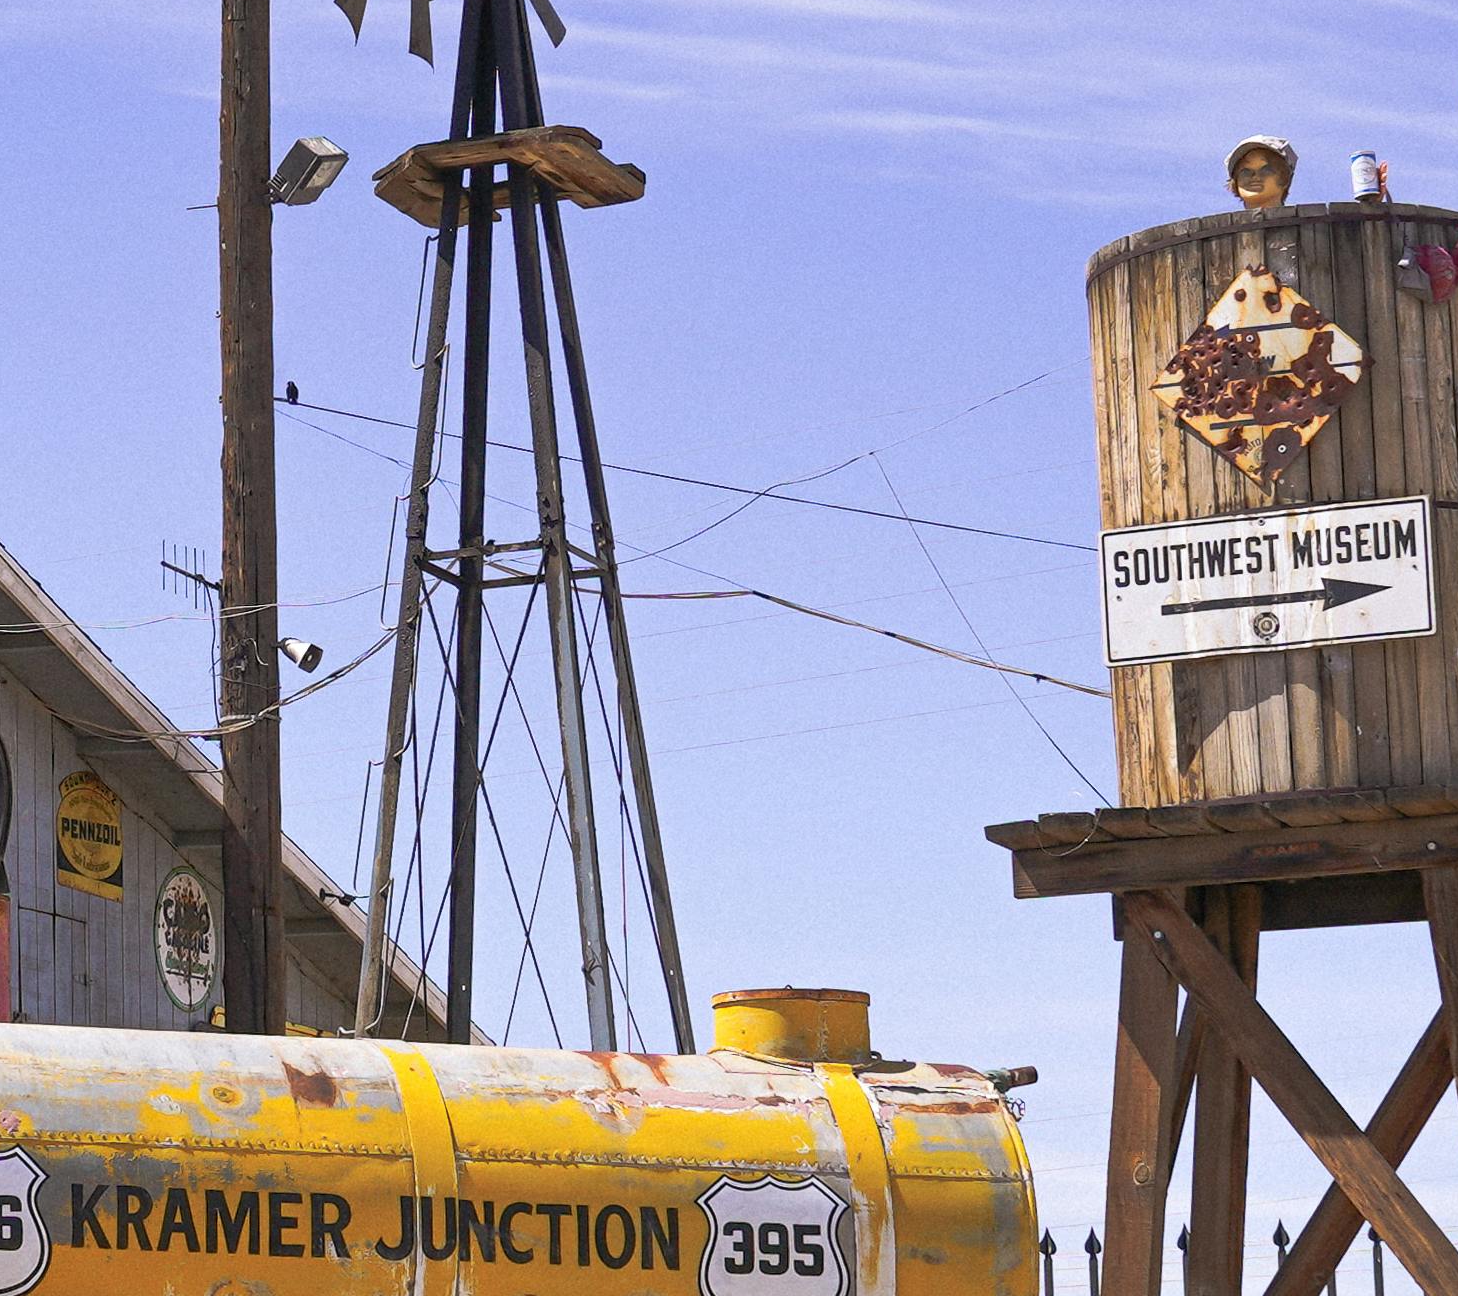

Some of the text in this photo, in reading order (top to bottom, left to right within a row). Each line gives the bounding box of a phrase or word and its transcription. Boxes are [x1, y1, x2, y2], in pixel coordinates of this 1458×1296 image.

[1113, 519, 1417, 588] SOUTHWEST MUSEUM
[61, 816, 121, 846] PENNZOIL
[70, 1183, 681, 1272] KRAMER JUNCTION
[722, 1221, 825, 1277] 395
